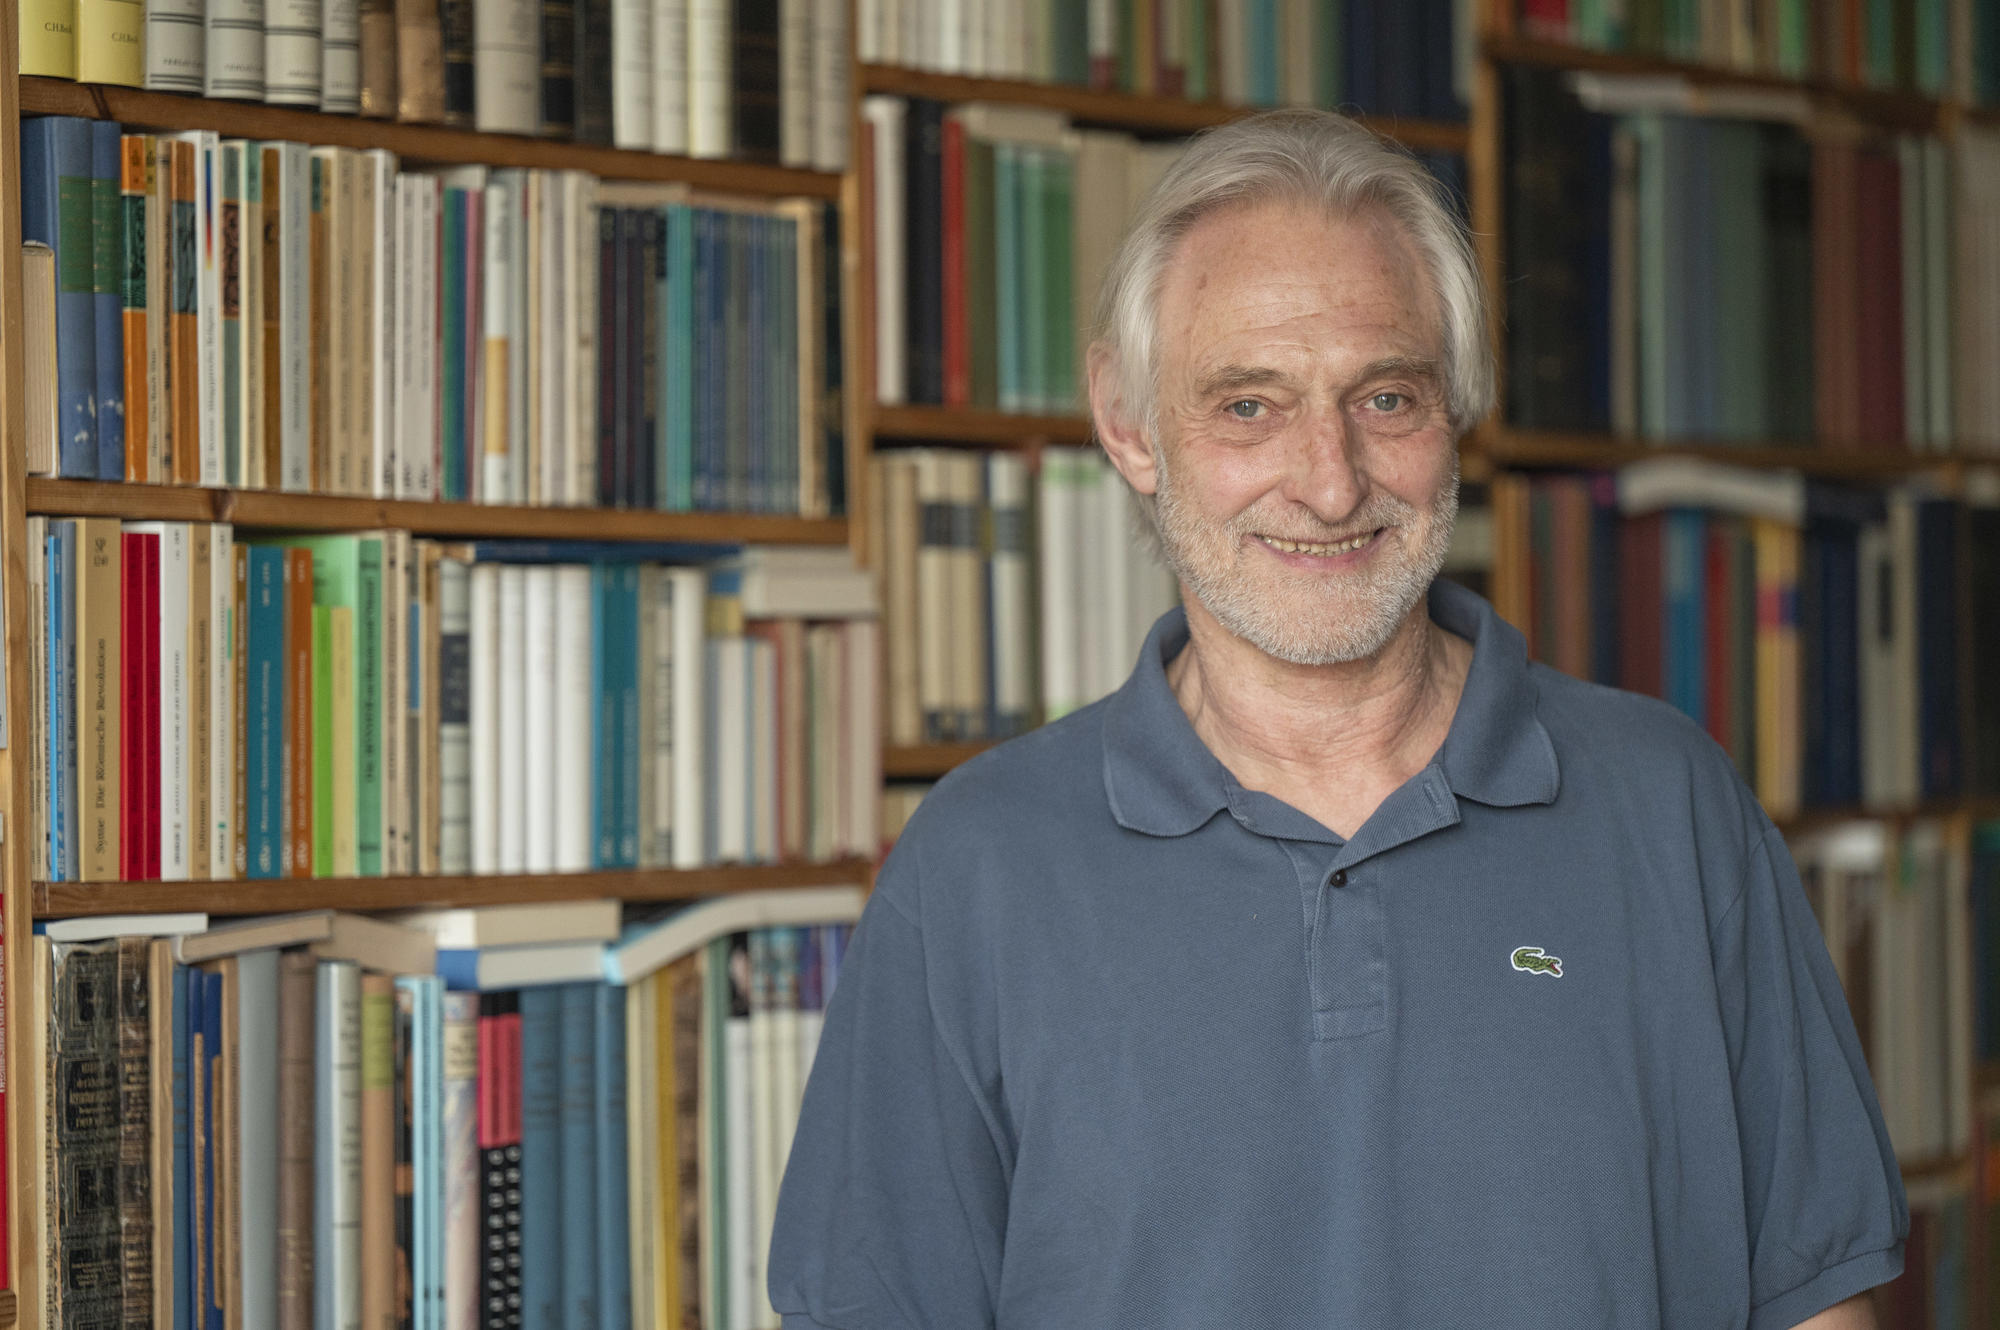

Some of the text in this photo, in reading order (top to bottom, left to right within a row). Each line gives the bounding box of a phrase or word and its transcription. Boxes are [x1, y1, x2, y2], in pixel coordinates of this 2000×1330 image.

[95, 638, 107, 854] Syme Die Römische Revolution
